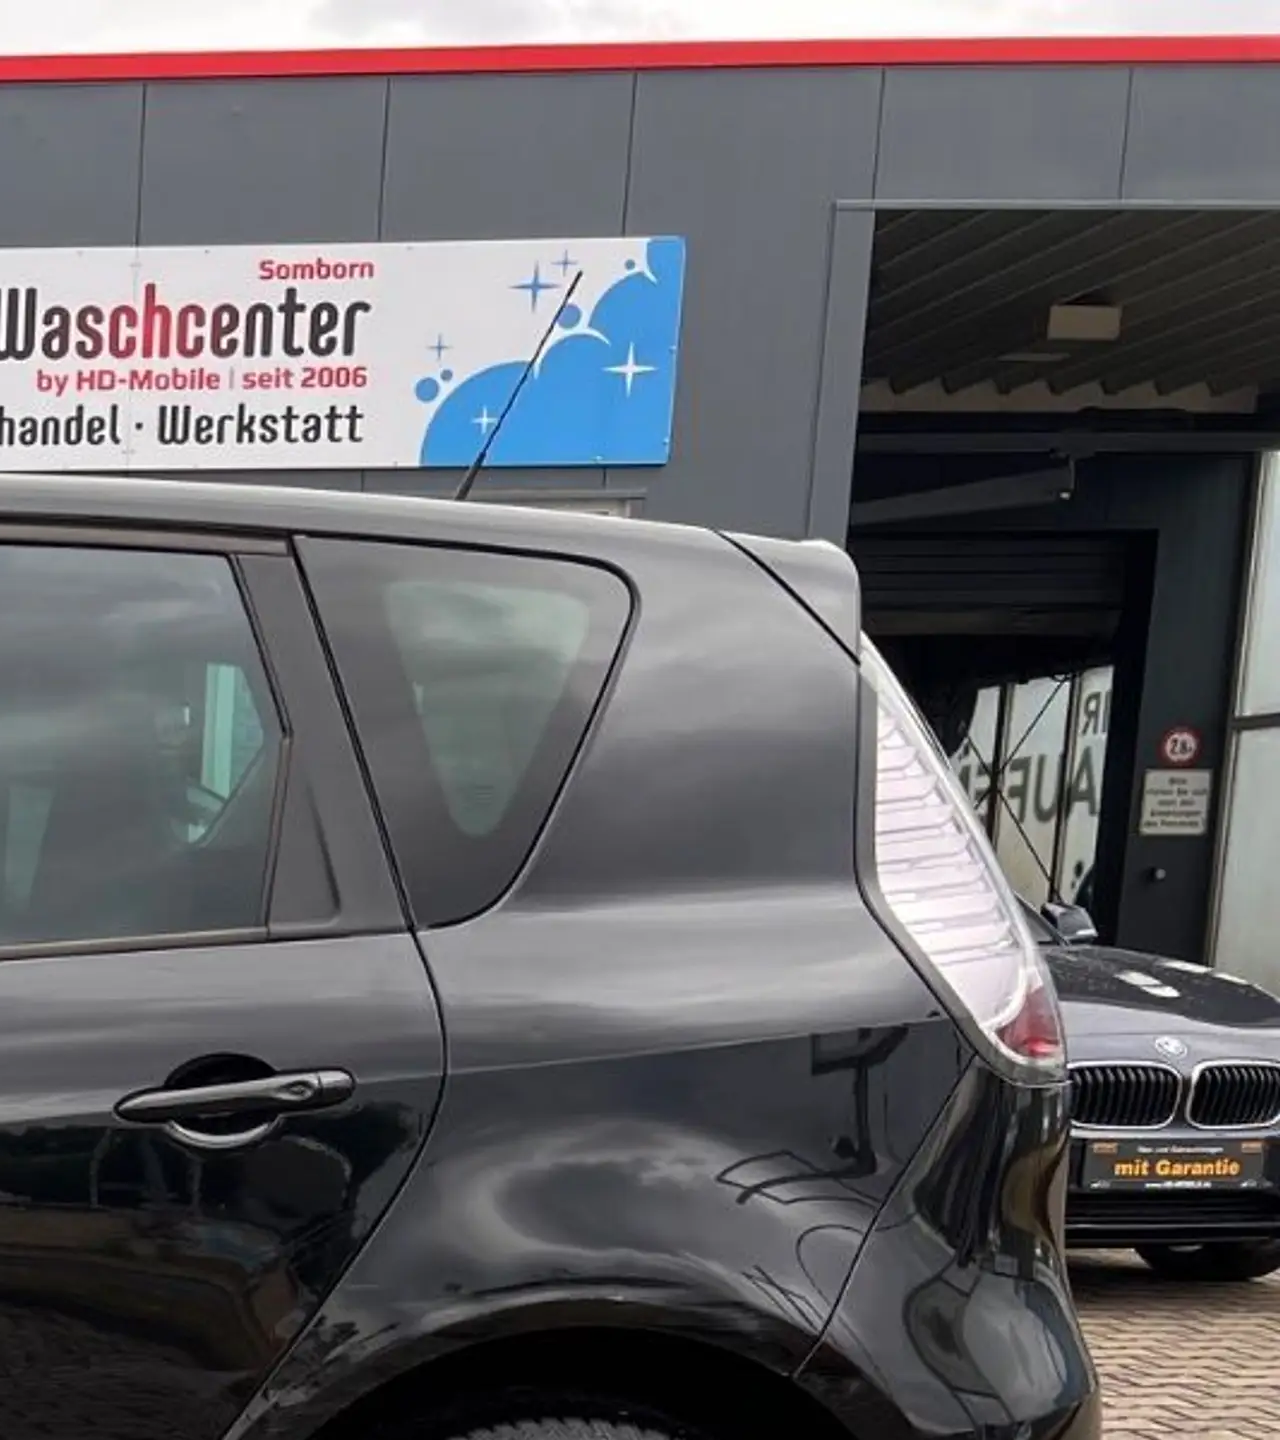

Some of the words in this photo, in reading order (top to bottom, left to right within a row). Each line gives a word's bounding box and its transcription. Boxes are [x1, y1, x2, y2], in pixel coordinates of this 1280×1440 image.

[259, 258, 374, 280] Somborn
[37, 370, 69, 396] by
[77, 367, 220, 391] HD-Mobile
[243, 366, 294, 389] seit
[301, 366, 367, 388] 2006
[157, 403, 363, 444] Werkstatt
[1114, 1160, 1150, 1176] mit
[1156, 1159, 1241, 1176] Garantie
